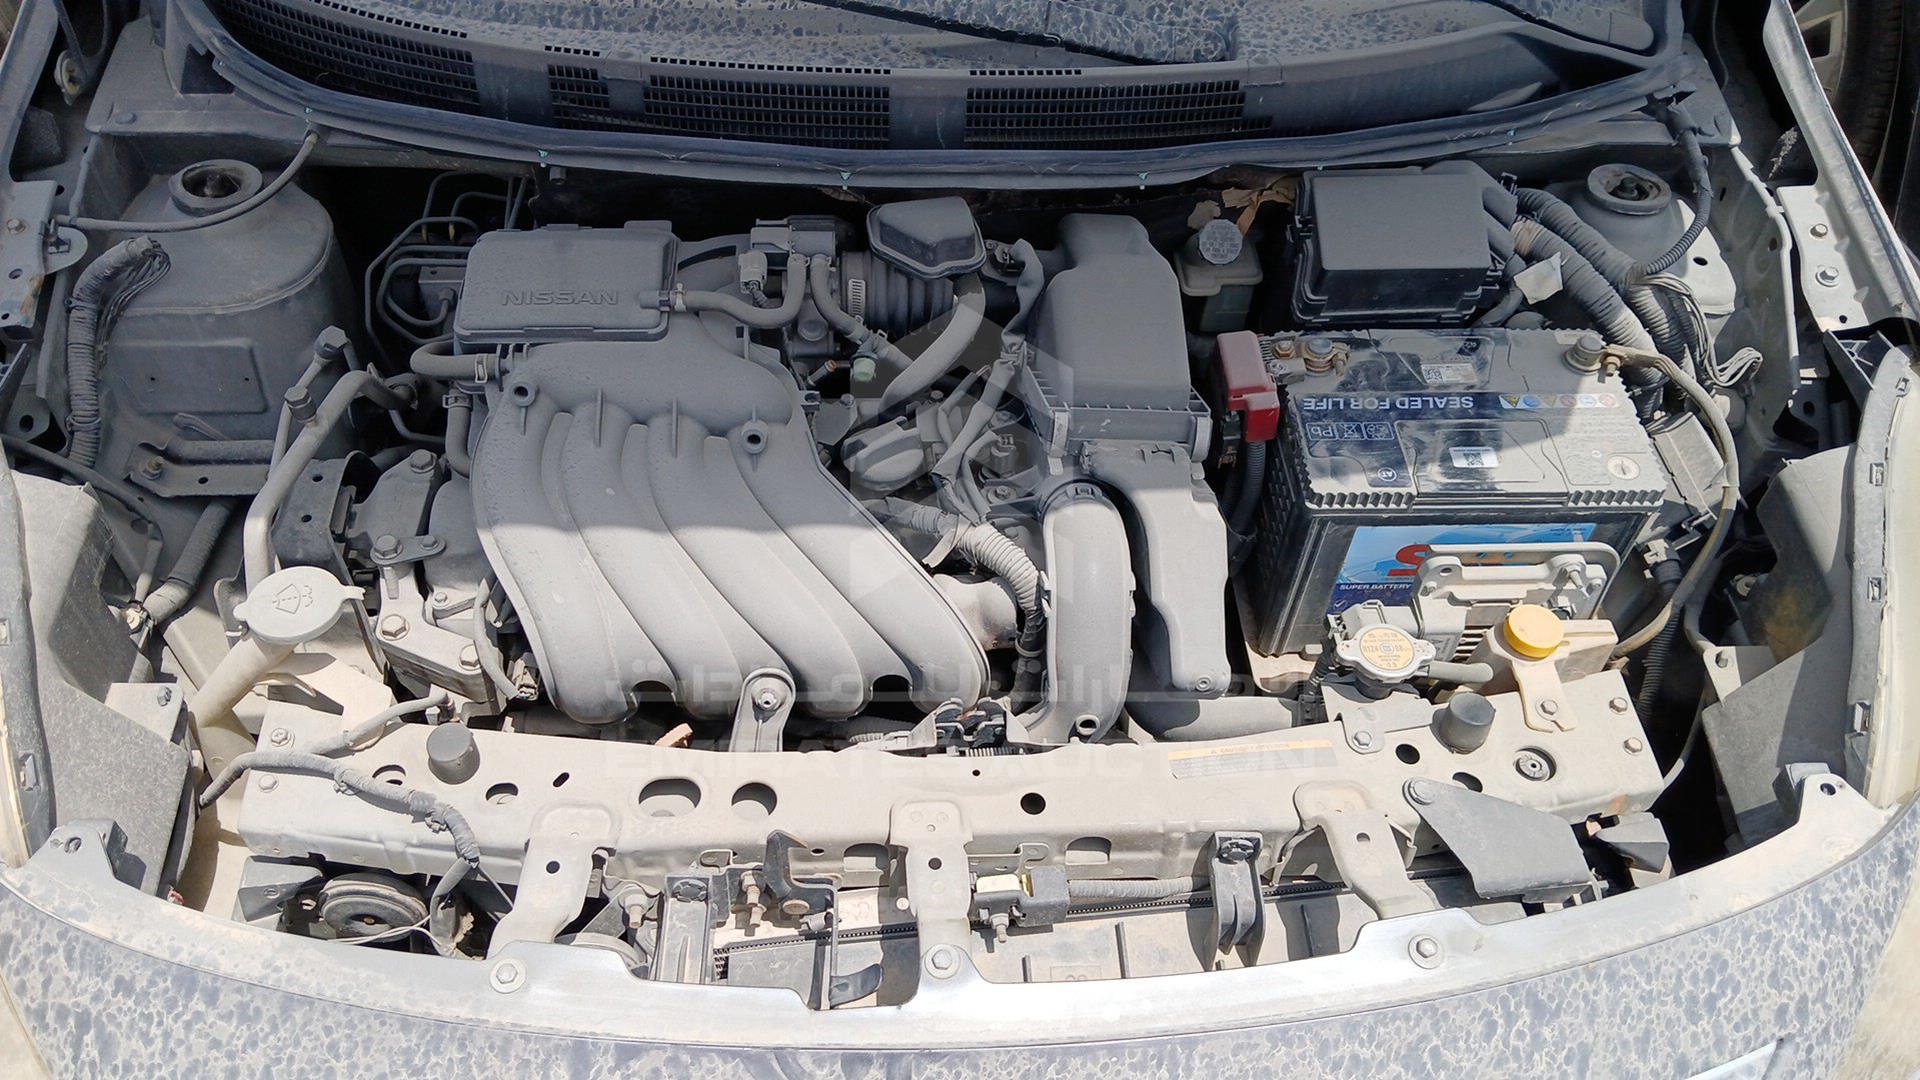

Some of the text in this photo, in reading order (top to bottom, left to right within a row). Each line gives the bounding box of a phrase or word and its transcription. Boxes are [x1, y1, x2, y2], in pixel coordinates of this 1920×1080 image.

[501, 289, 618, 306] NISSAN
[1303, 396, 1474, 410] SEALED FOR LIFE
[1310, 425, 1333, 437] Pb
